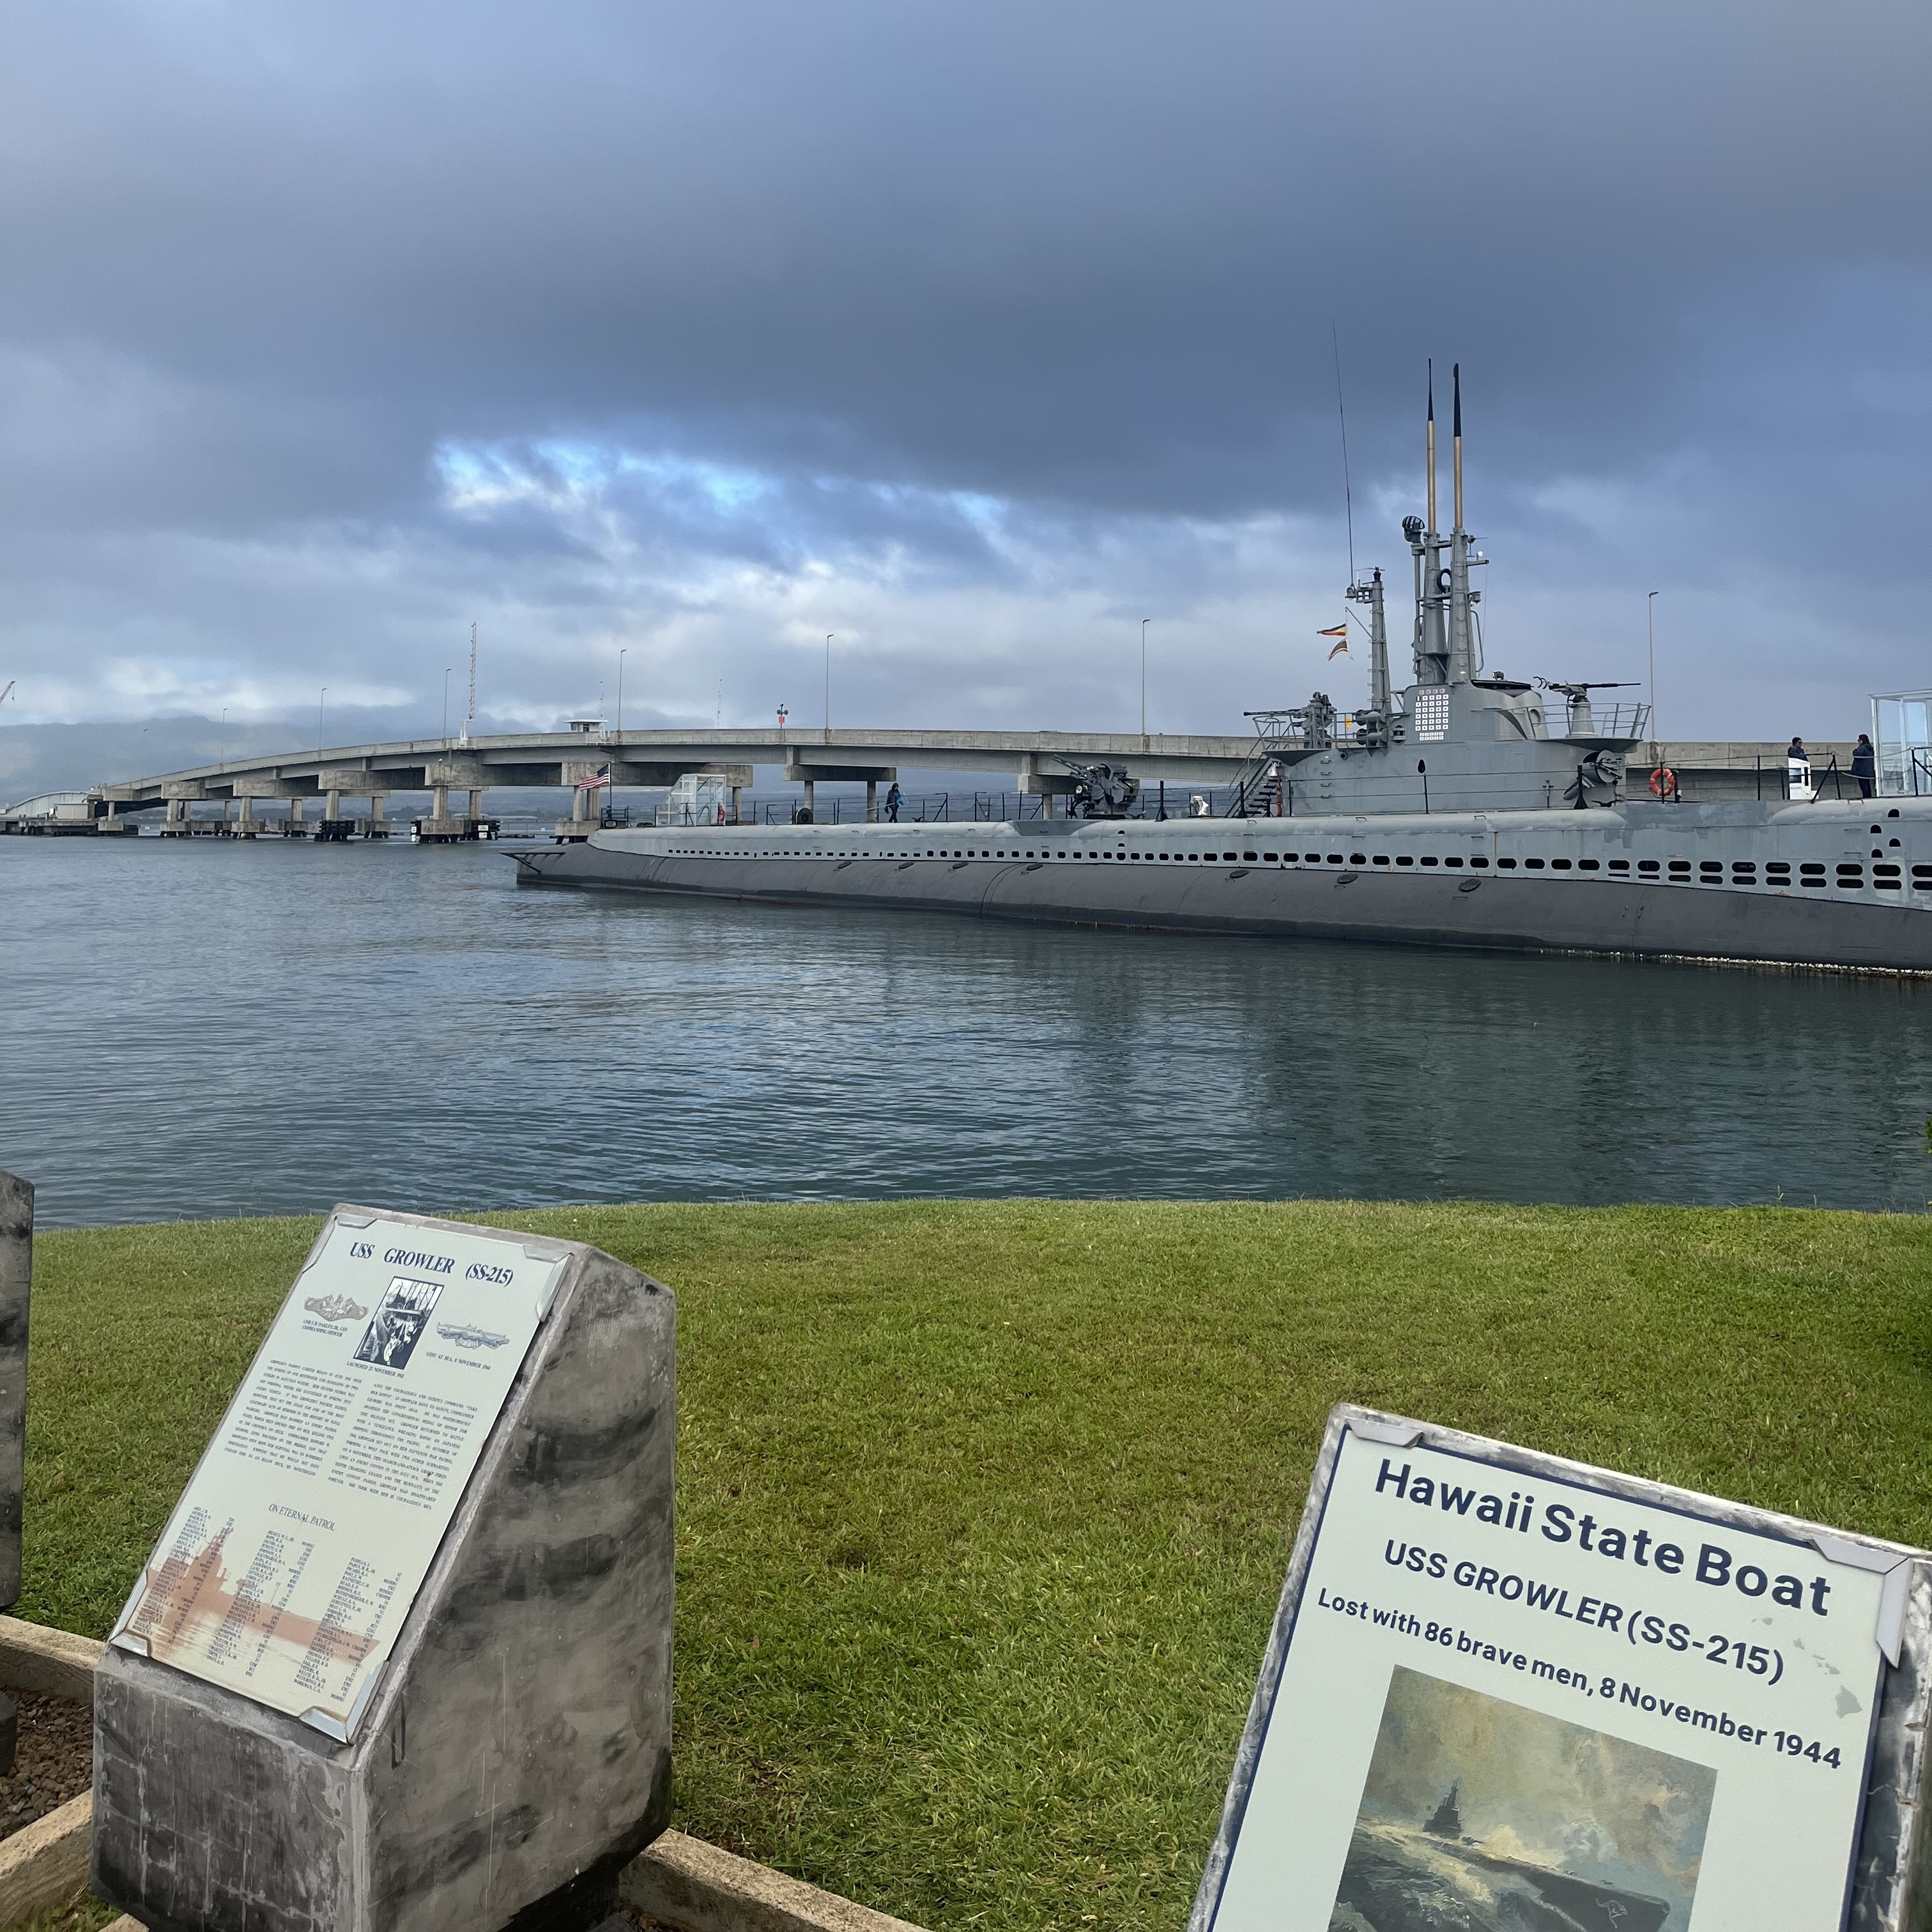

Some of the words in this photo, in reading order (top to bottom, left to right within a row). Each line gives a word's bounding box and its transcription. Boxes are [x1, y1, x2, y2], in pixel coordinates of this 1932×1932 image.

[349, 1242, 376, 1259] USS
[383, 1248, 456, 1274] GROWLER
[465, 1263, 514, 1288] (SS-215)
[374, 1367, 396, 1377] NOVEMBER
[458, 1358, 482, 1368] NOVEMBER
[268, 1503, 278, 1513] ON
[279, 1506, 309, 1523] ETERNAL
[310, 1516, 335, 1531] PATROL
[1375, 1458, 1535, 1533] Hawaii
[1541, 1504, 1684, 1574] State
[1695, 1543, 1831, 1616] Boat
[1385, 1539, 1448, 1578] USS
[1453, 1561, 1623, 1632] GROWLER
[1627, 1610, 1784, 1686] (SS-215)
[1318, 1588, 1368, 1620] Lost
[1373, 1608, 1421, 1637] with
[1425, 1621, 1453, 1646] 86
[1457, 1630, 1527, 1671] brave
[1531, 1660, 1594, 1697] men,
[1599, 1677, 1616, 1699] 8
[1620, 1682, 1768, 1746] November
[1773, 1730, 1841, 1770] 1944
